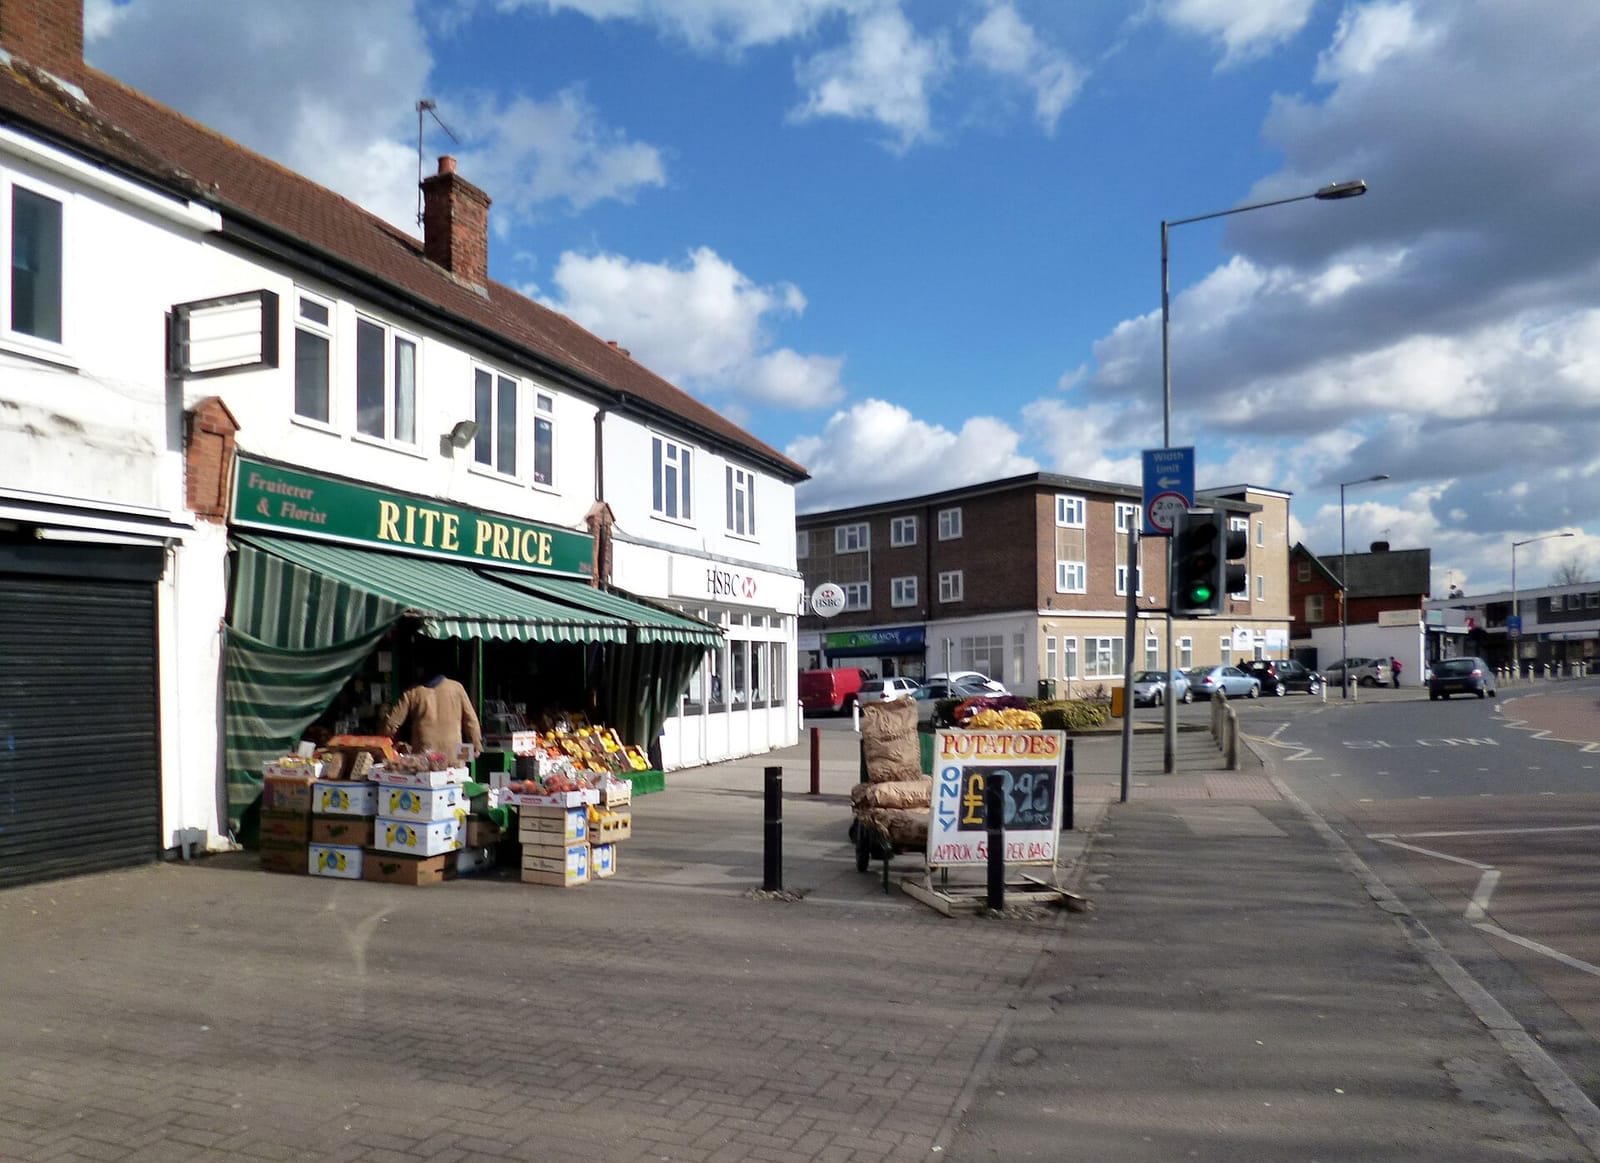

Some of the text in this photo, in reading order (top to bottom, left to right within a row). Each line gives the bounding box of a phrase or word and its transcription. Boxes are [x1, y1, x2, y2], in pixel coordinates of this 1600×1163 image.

[1152, 451, 1184, 462] Width
[248, 472, 315, 500] Fruiterer
[257, 497, 327, 525] & Florist
[377, 499, 553, 566] RITE PRICE
[707, 566, 740, 597] HSBC
[815, 598, 841, 608] HSBC
[942, 734, 1058, 756] POTATOES
[938, 766, 960, 833] ONLY
[1007, 842, 1025, 860] PER
[1028, 842, 1052, 859] BAG
